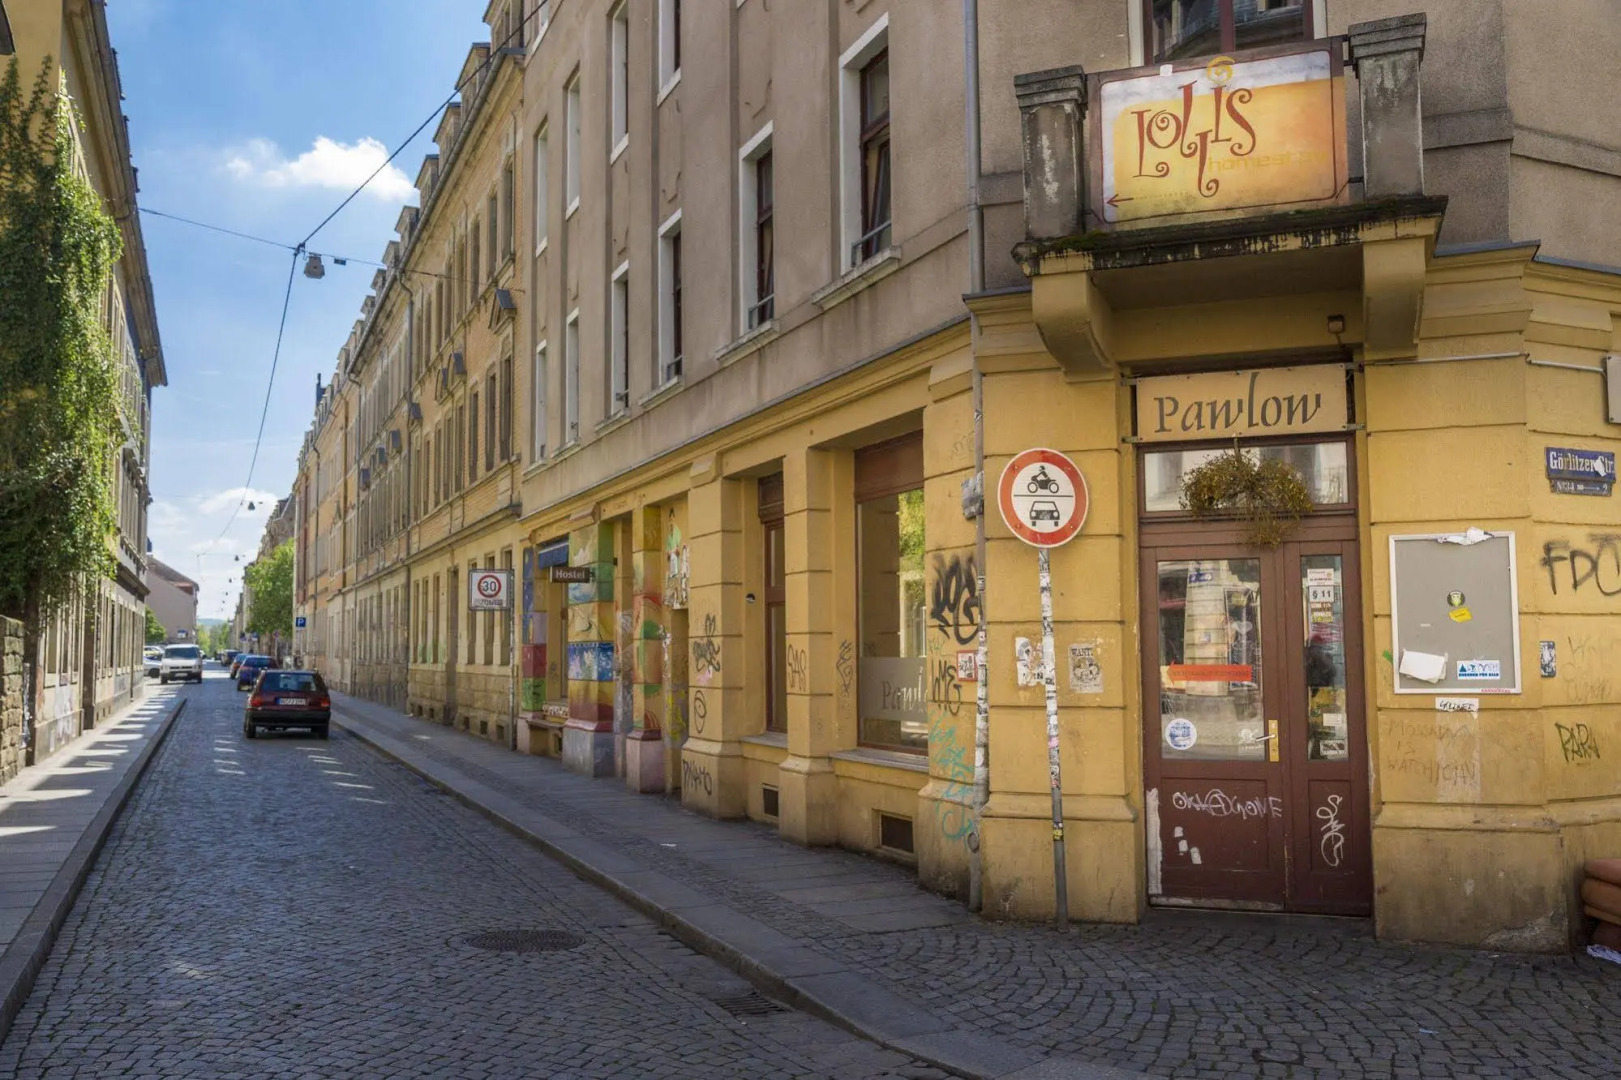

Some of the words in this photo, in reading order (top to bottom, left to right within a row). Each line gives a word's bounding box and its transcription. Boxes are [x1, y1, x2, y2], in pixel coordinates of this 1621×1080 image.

[1153, 372, 1322, 433] Pawlow
[555, 568, 586, 580] Hostel
[482, 580, 497, 592] 30
